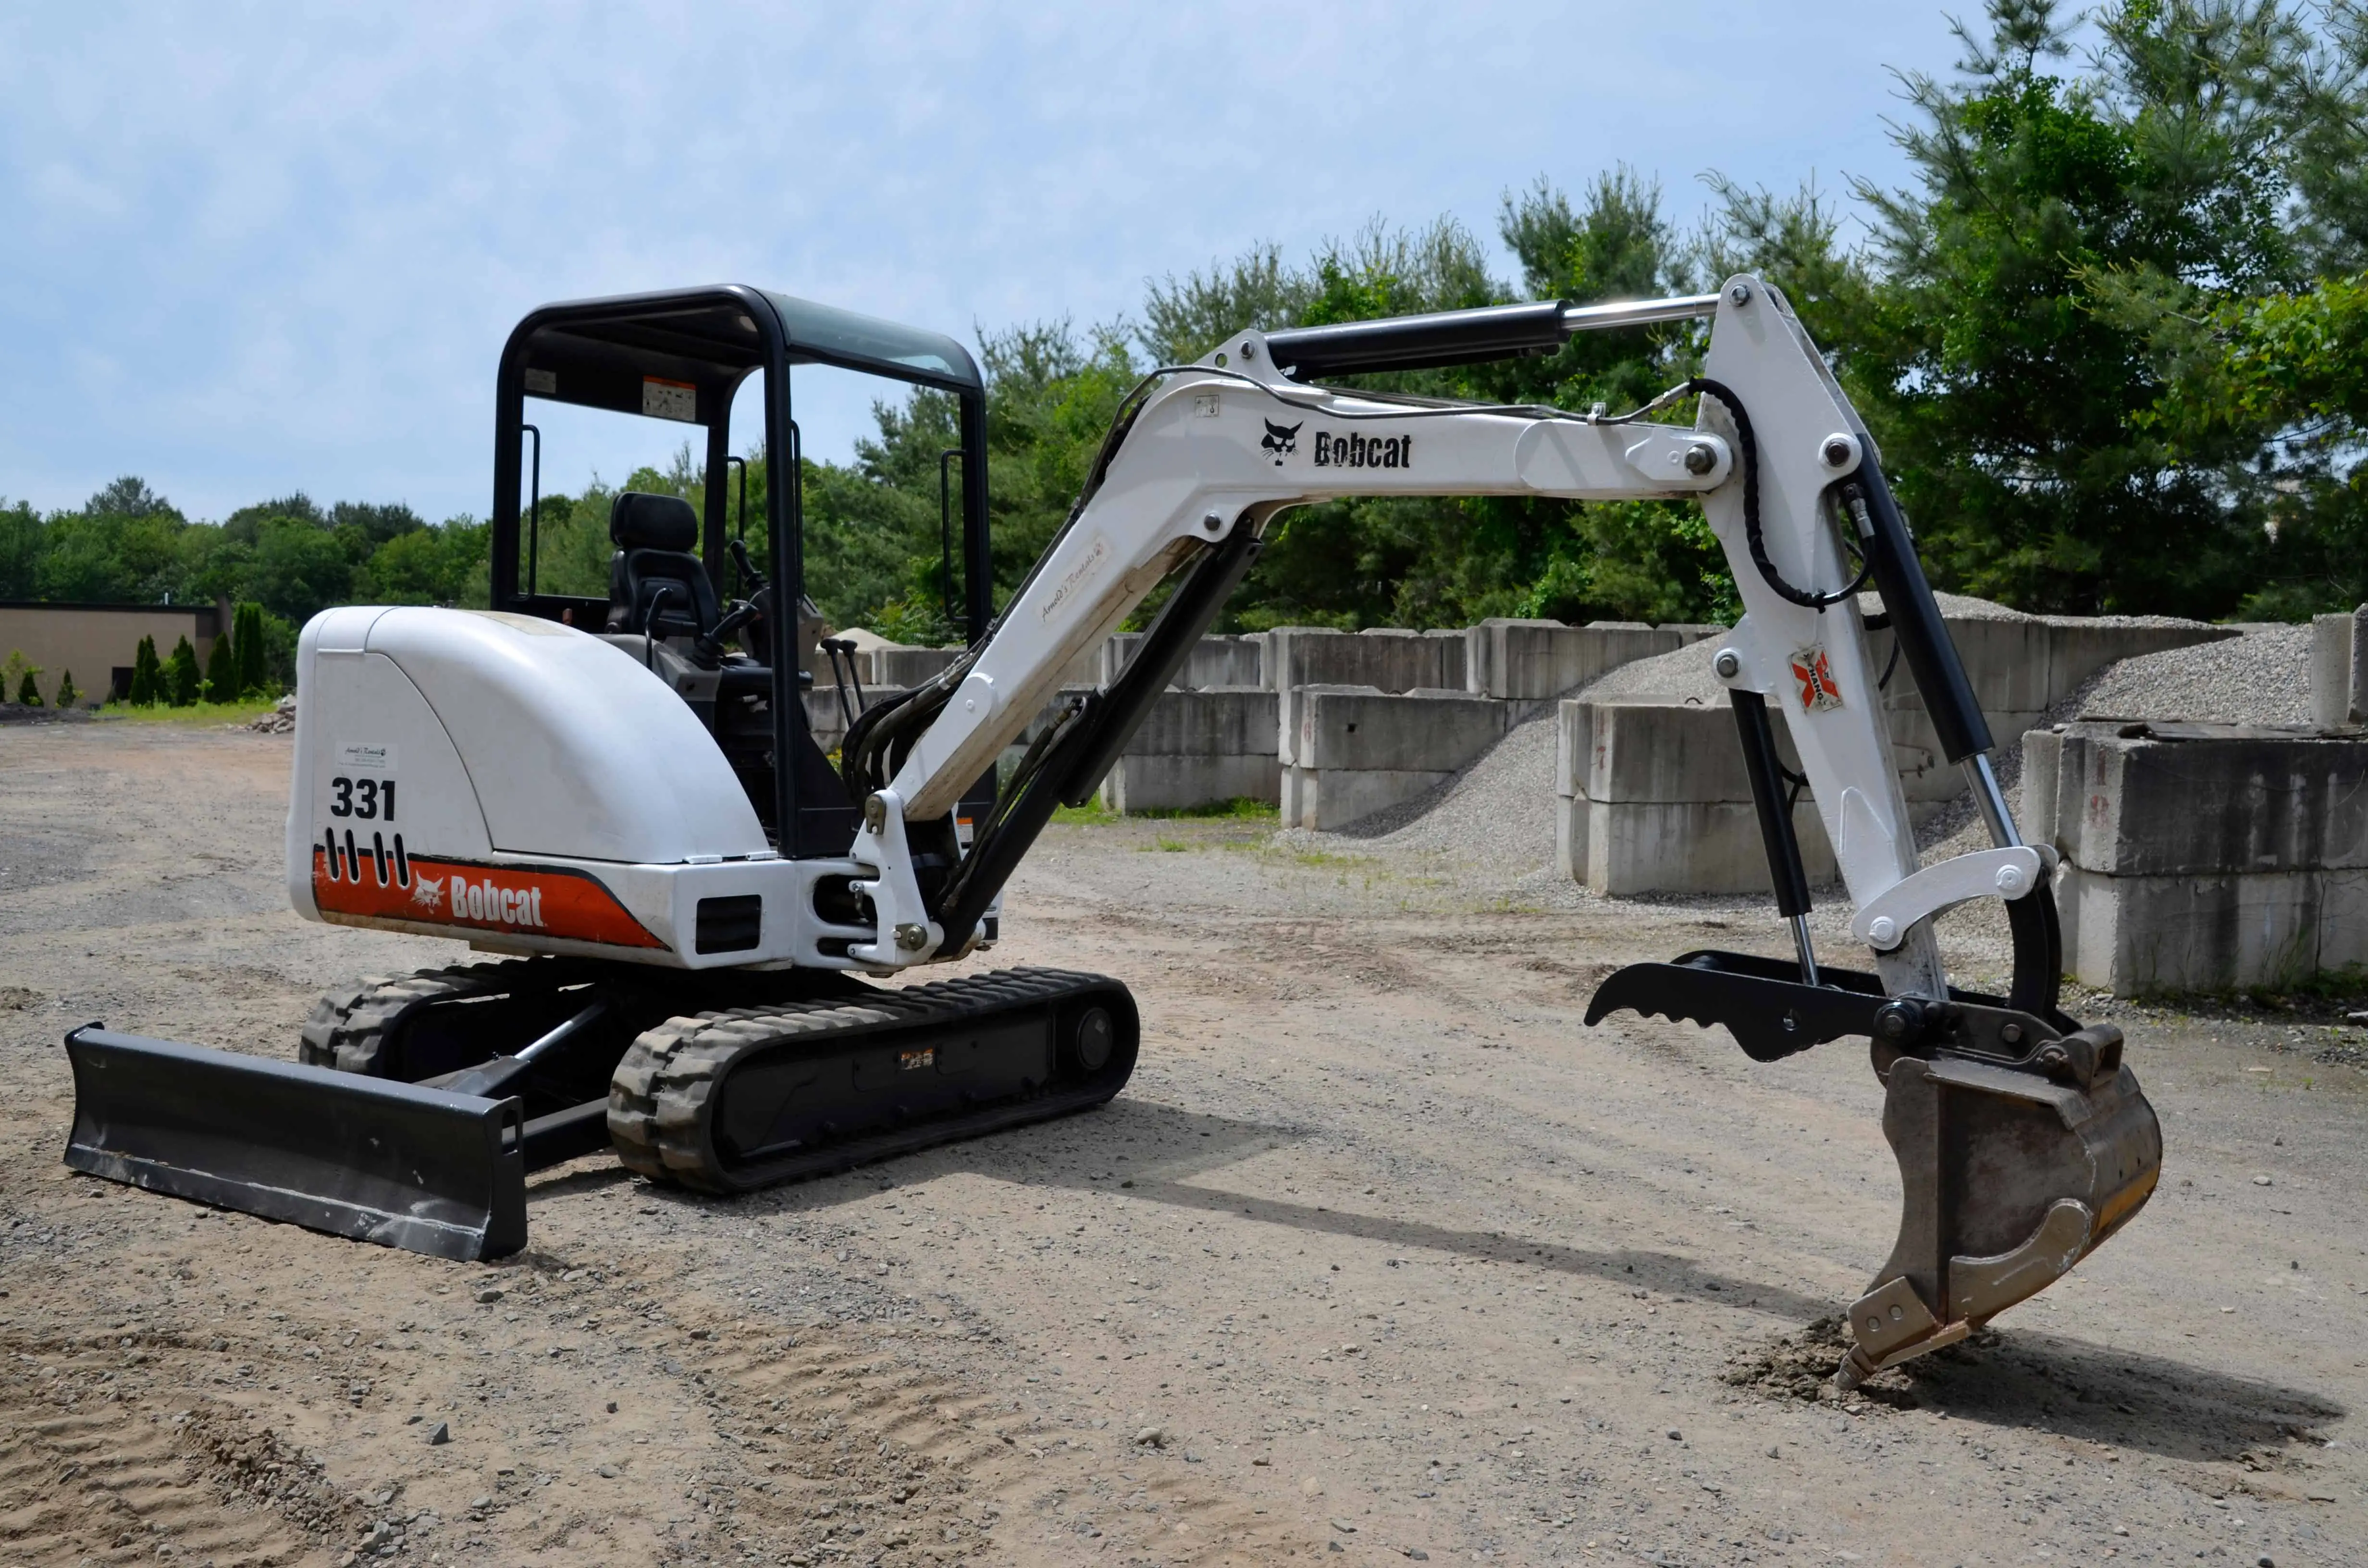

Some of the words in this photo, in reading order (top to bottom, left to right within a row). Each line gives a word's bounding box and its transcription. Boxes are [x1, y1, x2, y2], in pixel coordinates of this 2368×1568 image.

[1314, 431, 1412, 468] Bobcat
[1066, 554, 1095, 589] Rentals
[331, 777, 395, 821] 331
[451, 876, 545, 927] Bobcat
